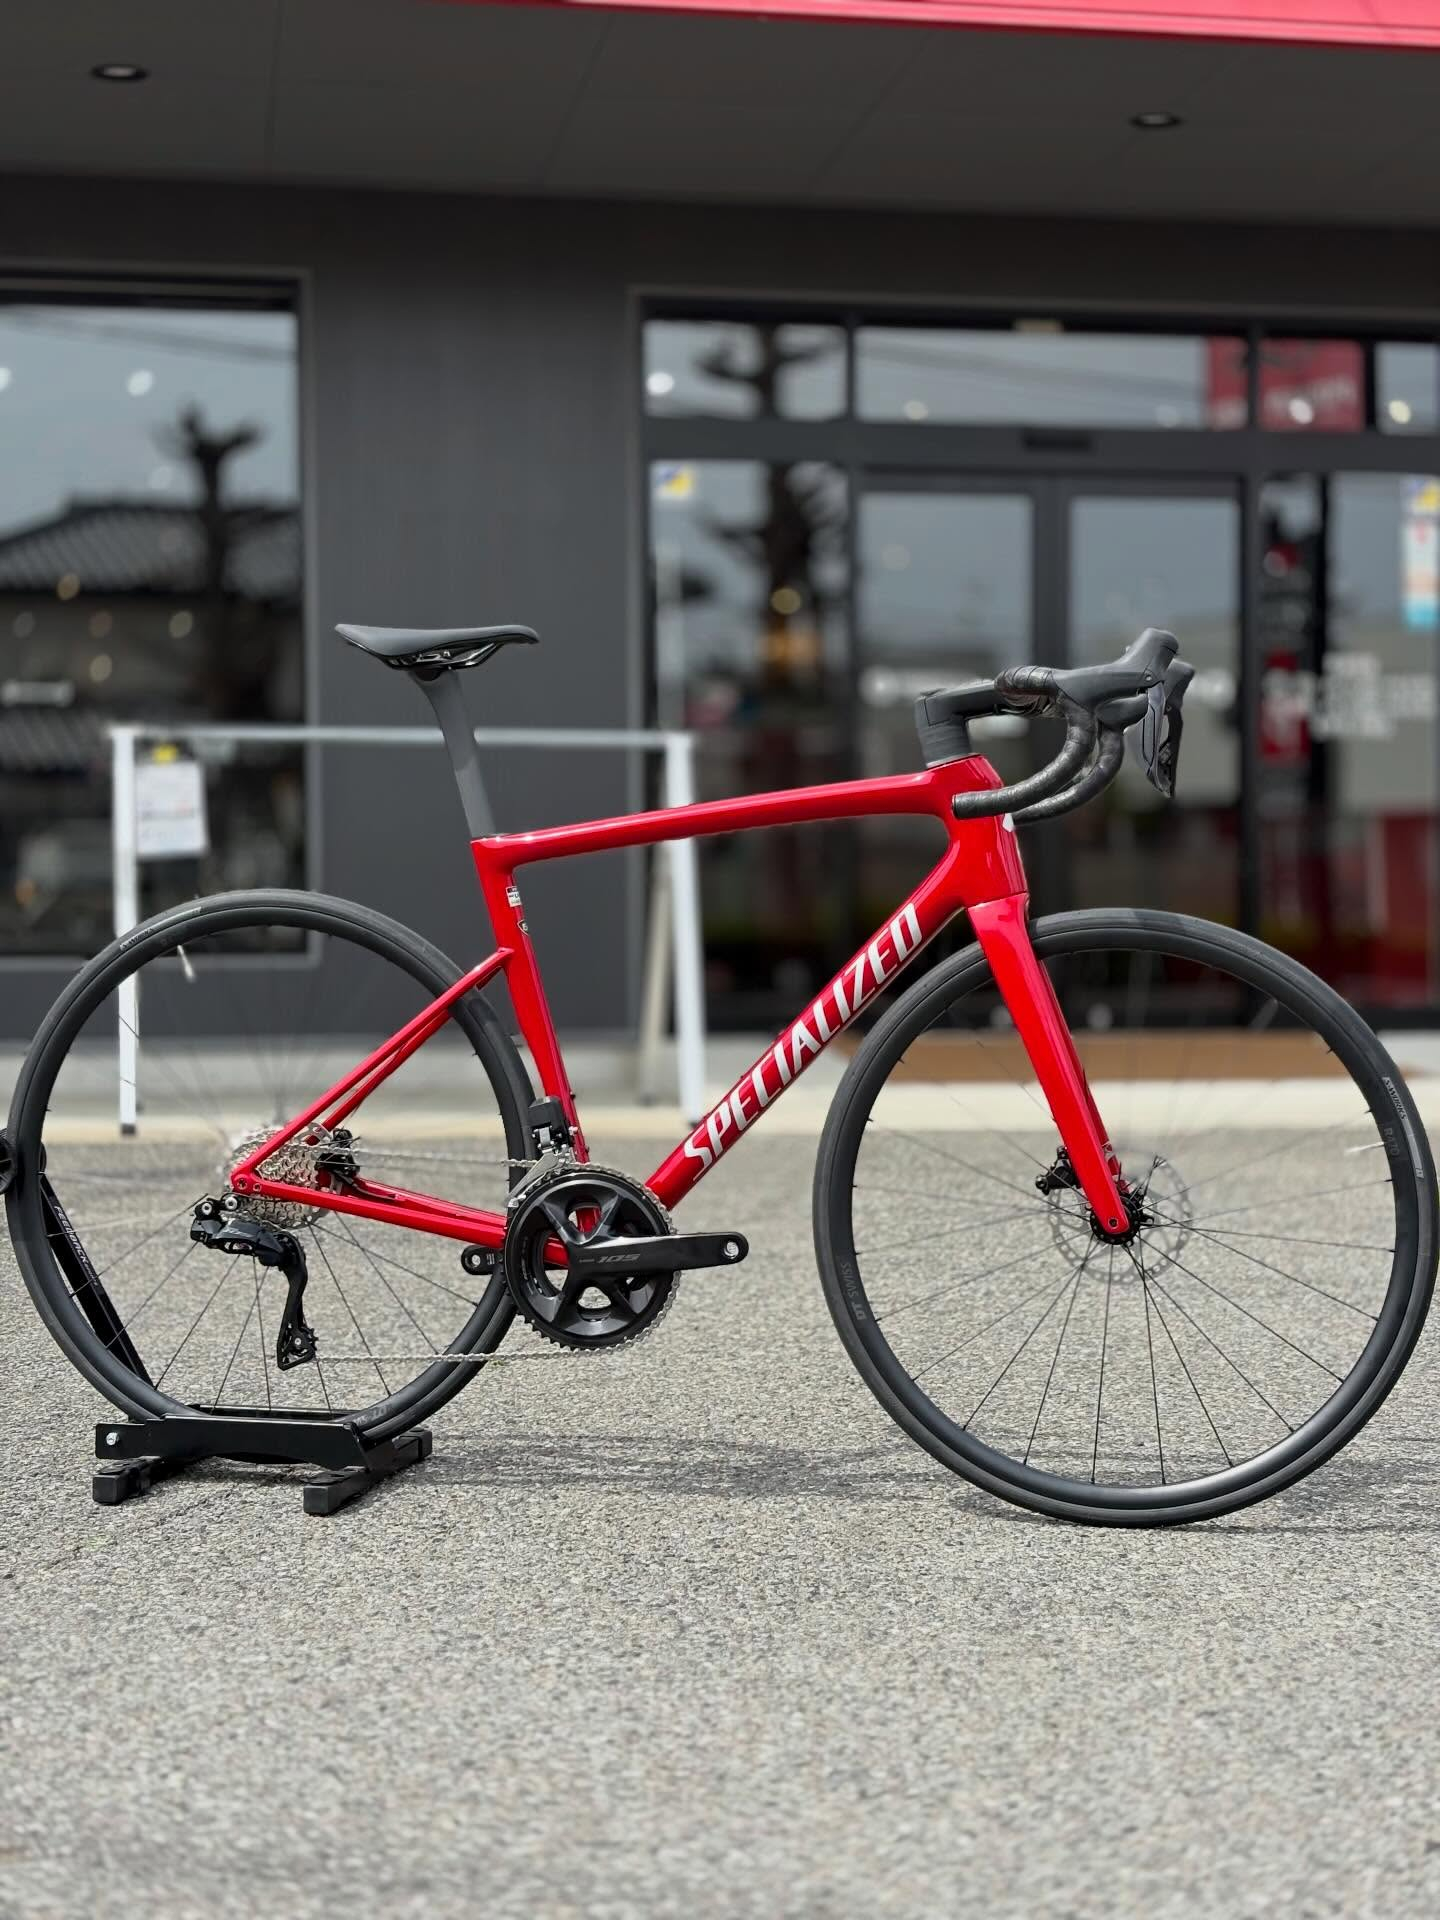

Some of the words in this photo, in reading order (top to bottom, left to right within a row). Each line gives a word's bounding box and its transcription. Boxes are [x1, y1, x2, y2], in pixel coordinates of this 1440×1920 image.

[684, 902, 923, 1182] SPECIALIZED
[597, 1253, 641, 1264] 105
[850, 1301, 868, 1320] DT
